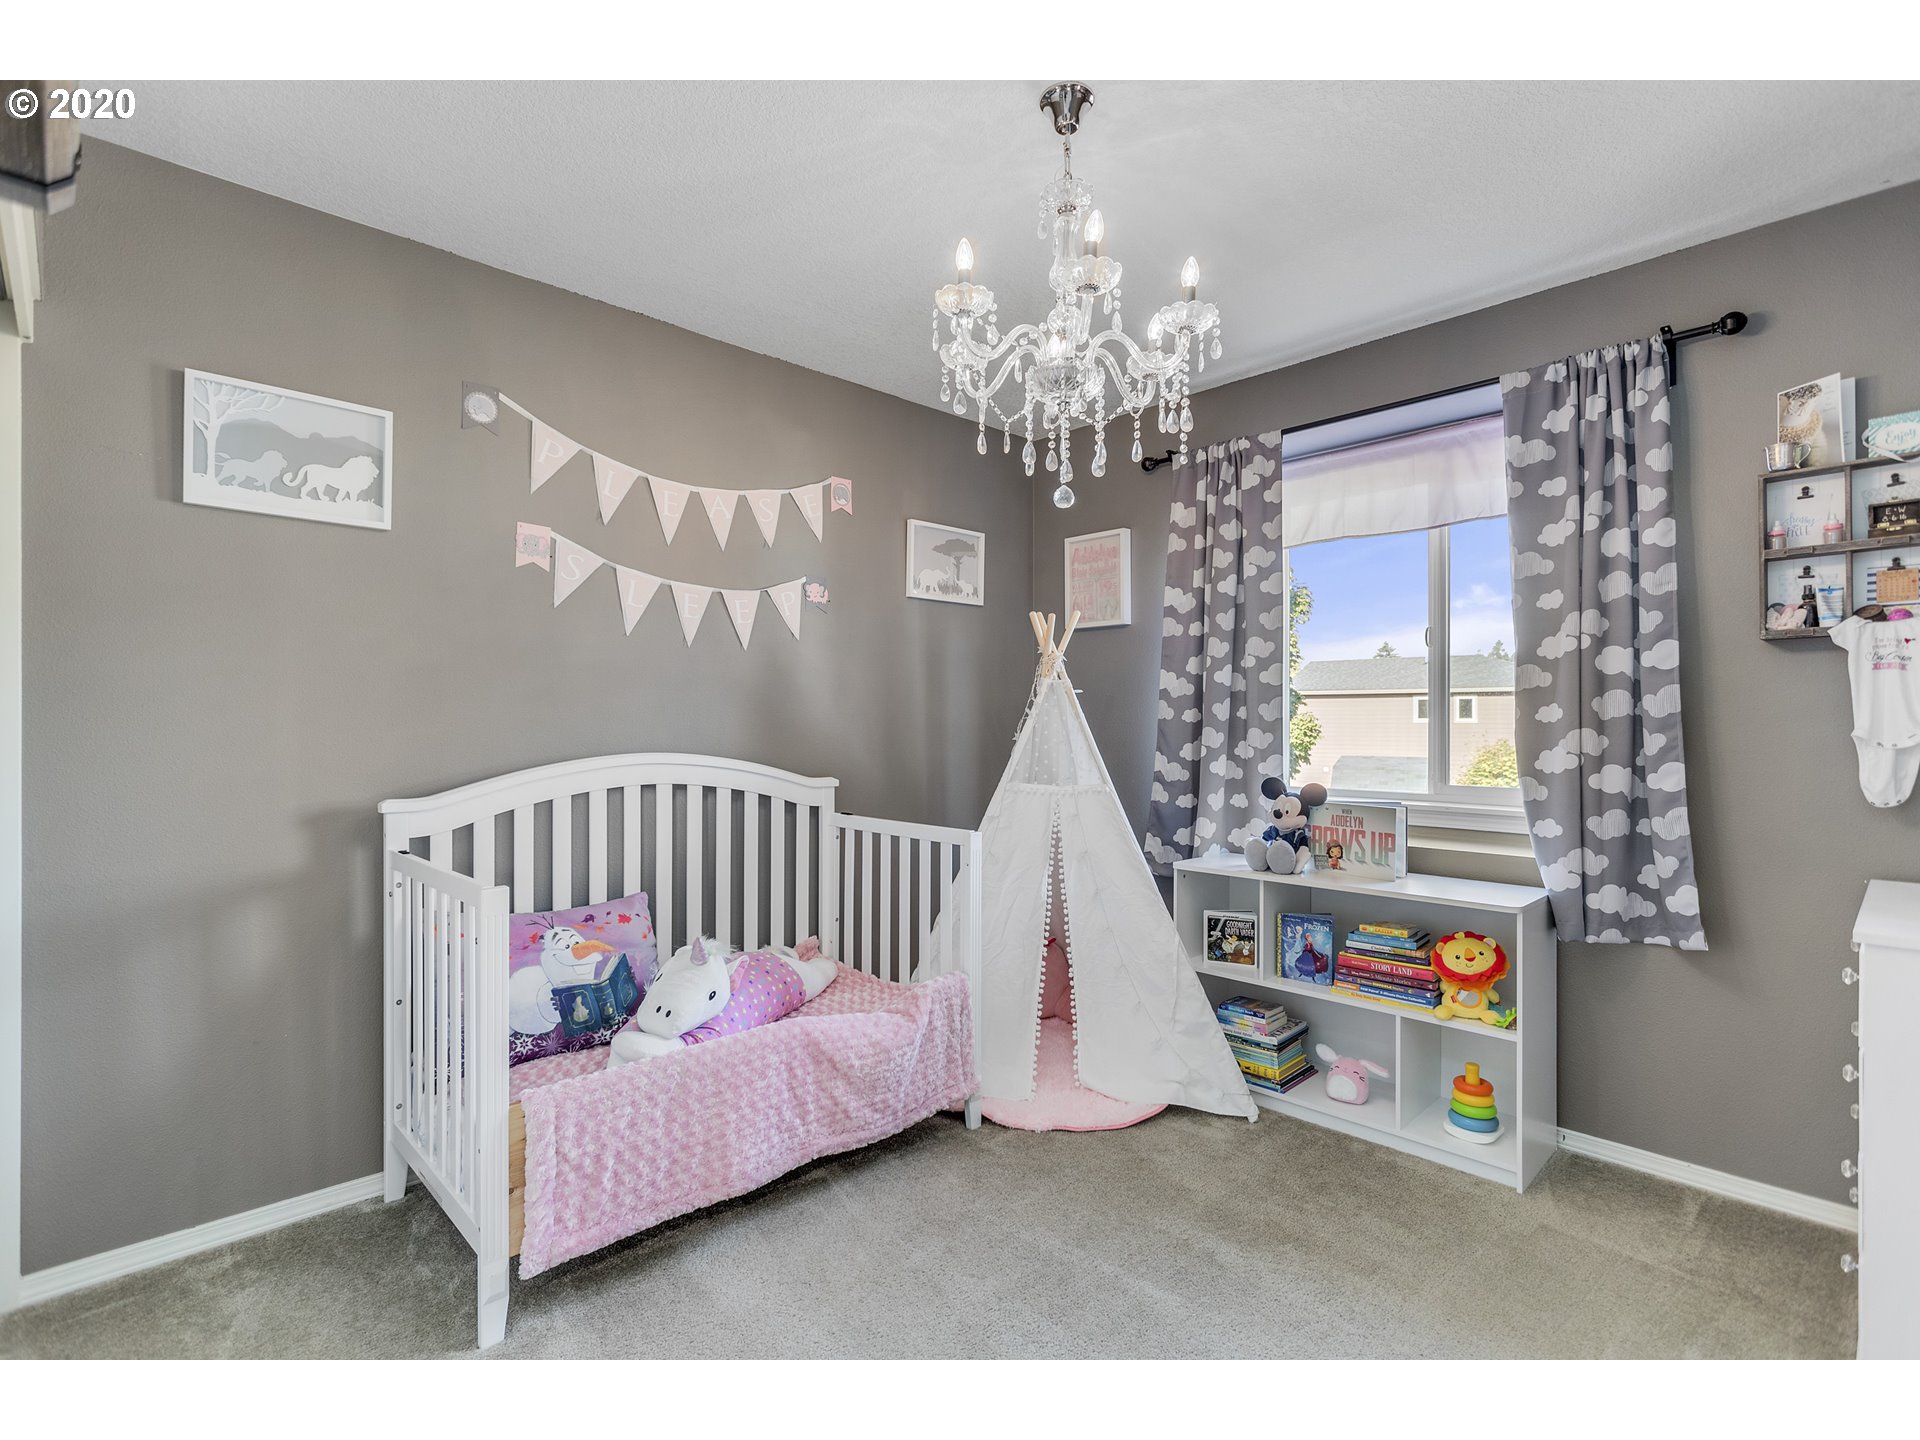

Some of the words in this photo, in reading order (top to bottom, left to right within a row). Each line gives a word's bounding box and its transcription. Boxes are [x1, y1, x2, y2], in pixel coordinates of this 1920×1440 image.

[1885, 428, 1918, 446] Enjoy
[537, 437, 823, 523] PLEASE
[560, 553, 795, 625] SLEEP
[1330, 814, 1364, 829] ADDELYN
[1305, 824, 1366, 863] ROWS
[1370, 830, 1396, 866] UP
[1224, 927, 1240, 936] DARTH
[1240, 928, 1255, 937] VADER
[1225, 920, 1253, 930] GOODNIGHT
[1303, 922, 1330, 932] FROZEN
[1370, 962, 1392, 974] STORY
[1392, 967, 1413, 976] LAND
